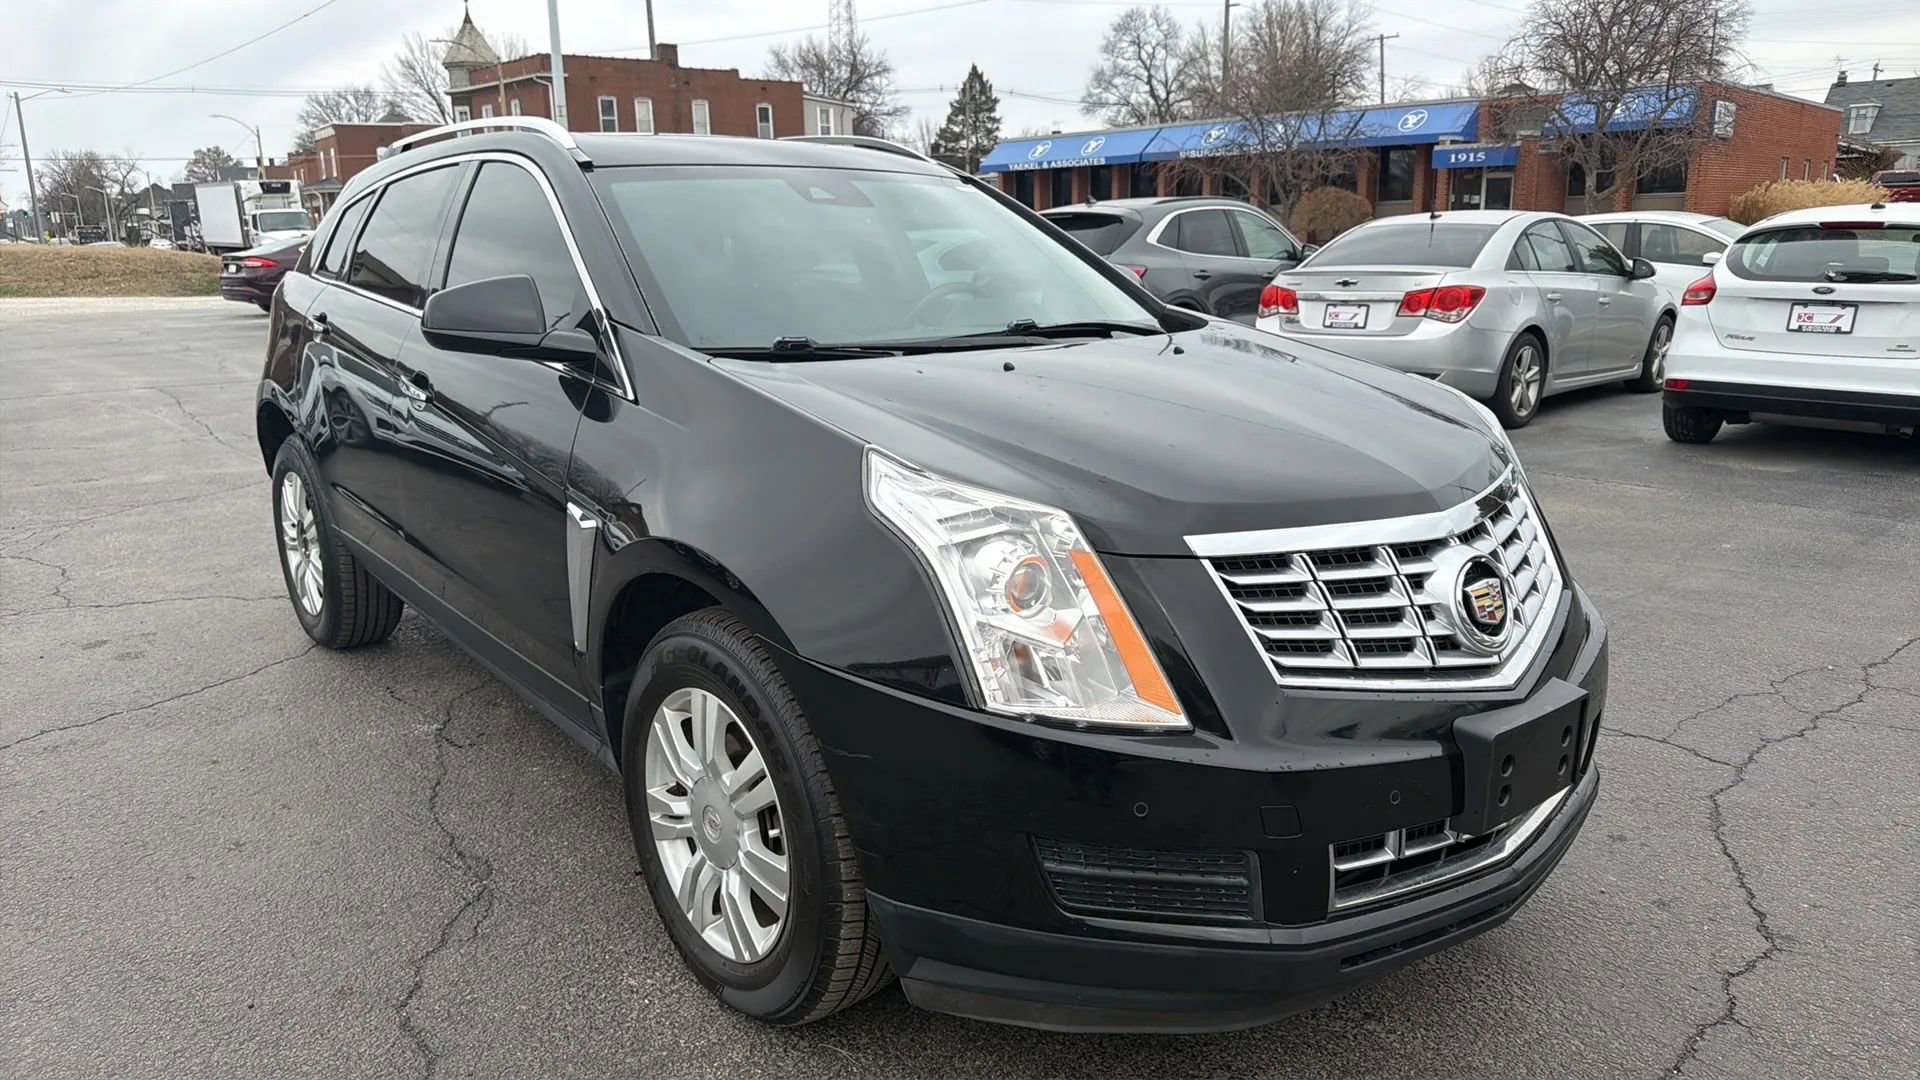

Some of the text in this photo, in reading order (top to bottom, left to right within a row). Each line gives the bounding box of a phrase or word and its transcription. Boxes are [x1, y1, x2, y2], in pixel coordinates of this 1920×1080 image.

[1042, 161, 1049, 169] &
[1050, 157, 1106, 168] ASSOCIATES
[1449, 151, 1486, 163] 1915
